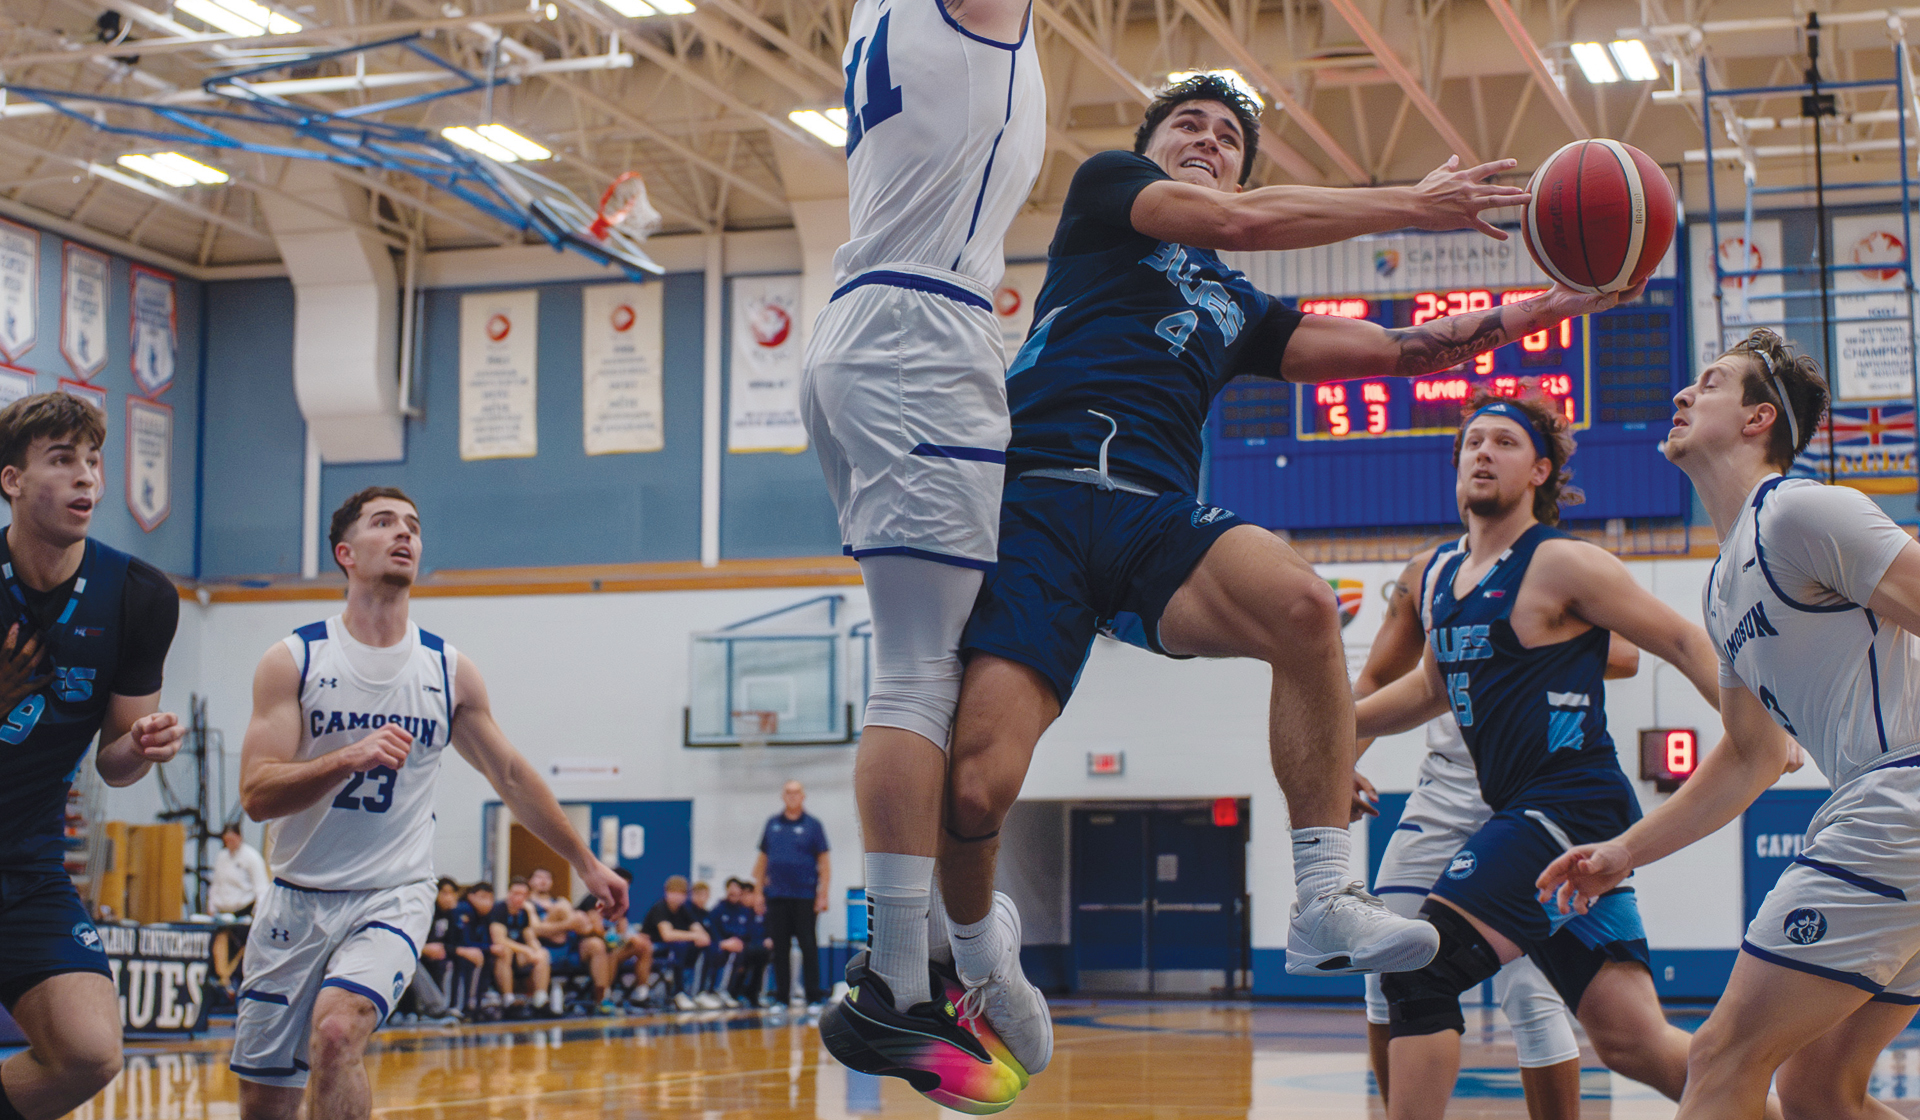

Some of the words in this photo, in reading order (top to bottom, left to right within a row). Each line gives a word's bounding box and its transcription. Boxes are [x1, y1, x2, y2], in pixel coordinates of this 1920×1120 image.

[1407, 246, 1509, 262] CAPILANO
[1155, 310, 1199, 358] 4
[1329, 405, 1349, 436] 5
[1368, 404, 1387, 434] 3
[1430, 624, 1494, 662] LUES
[1667, 732, 1693, 773] 8
[332, 764, 398, 814] 23
[109, 958, 209, 1029] LUES
